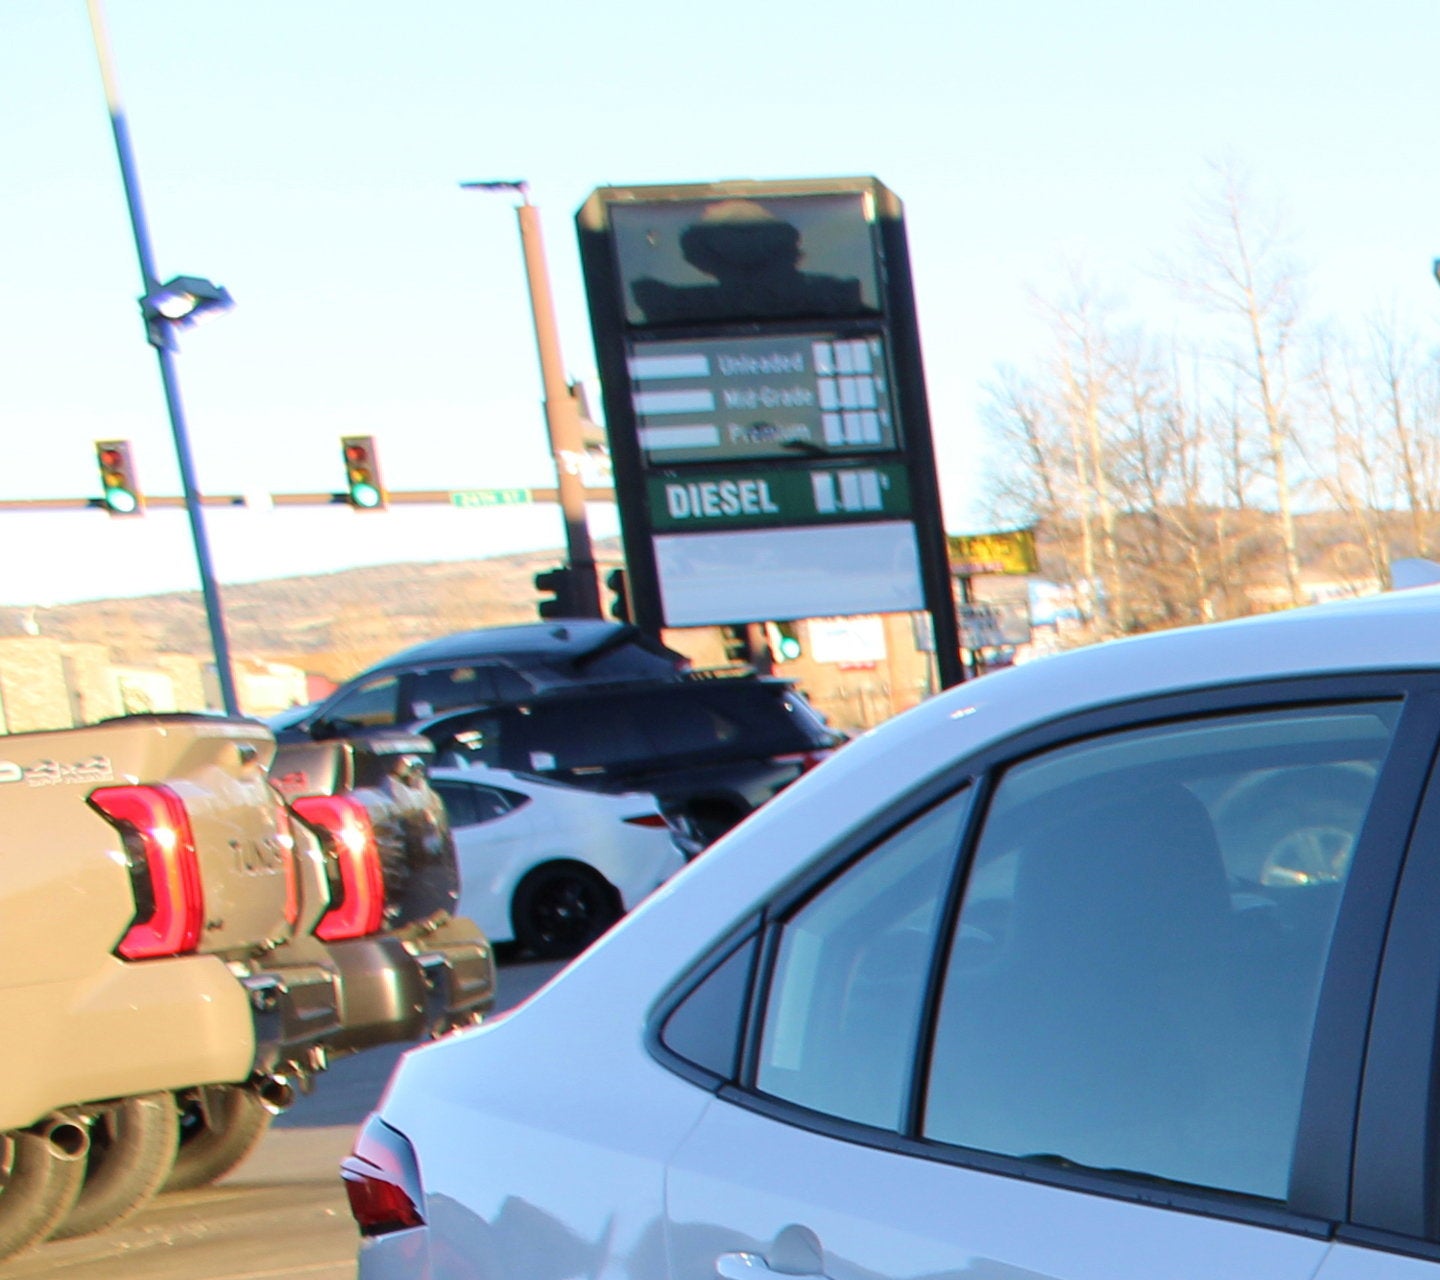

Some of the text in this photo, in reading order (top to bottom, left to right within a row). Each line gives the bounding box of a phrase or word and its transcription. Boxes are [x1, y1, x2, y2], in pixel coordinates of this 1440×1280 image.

[718, 353, 804, 376] Unleaded
[723, 385, 814, 409] Mid-Grade
[665, 478, 779, 519] DIESEL
